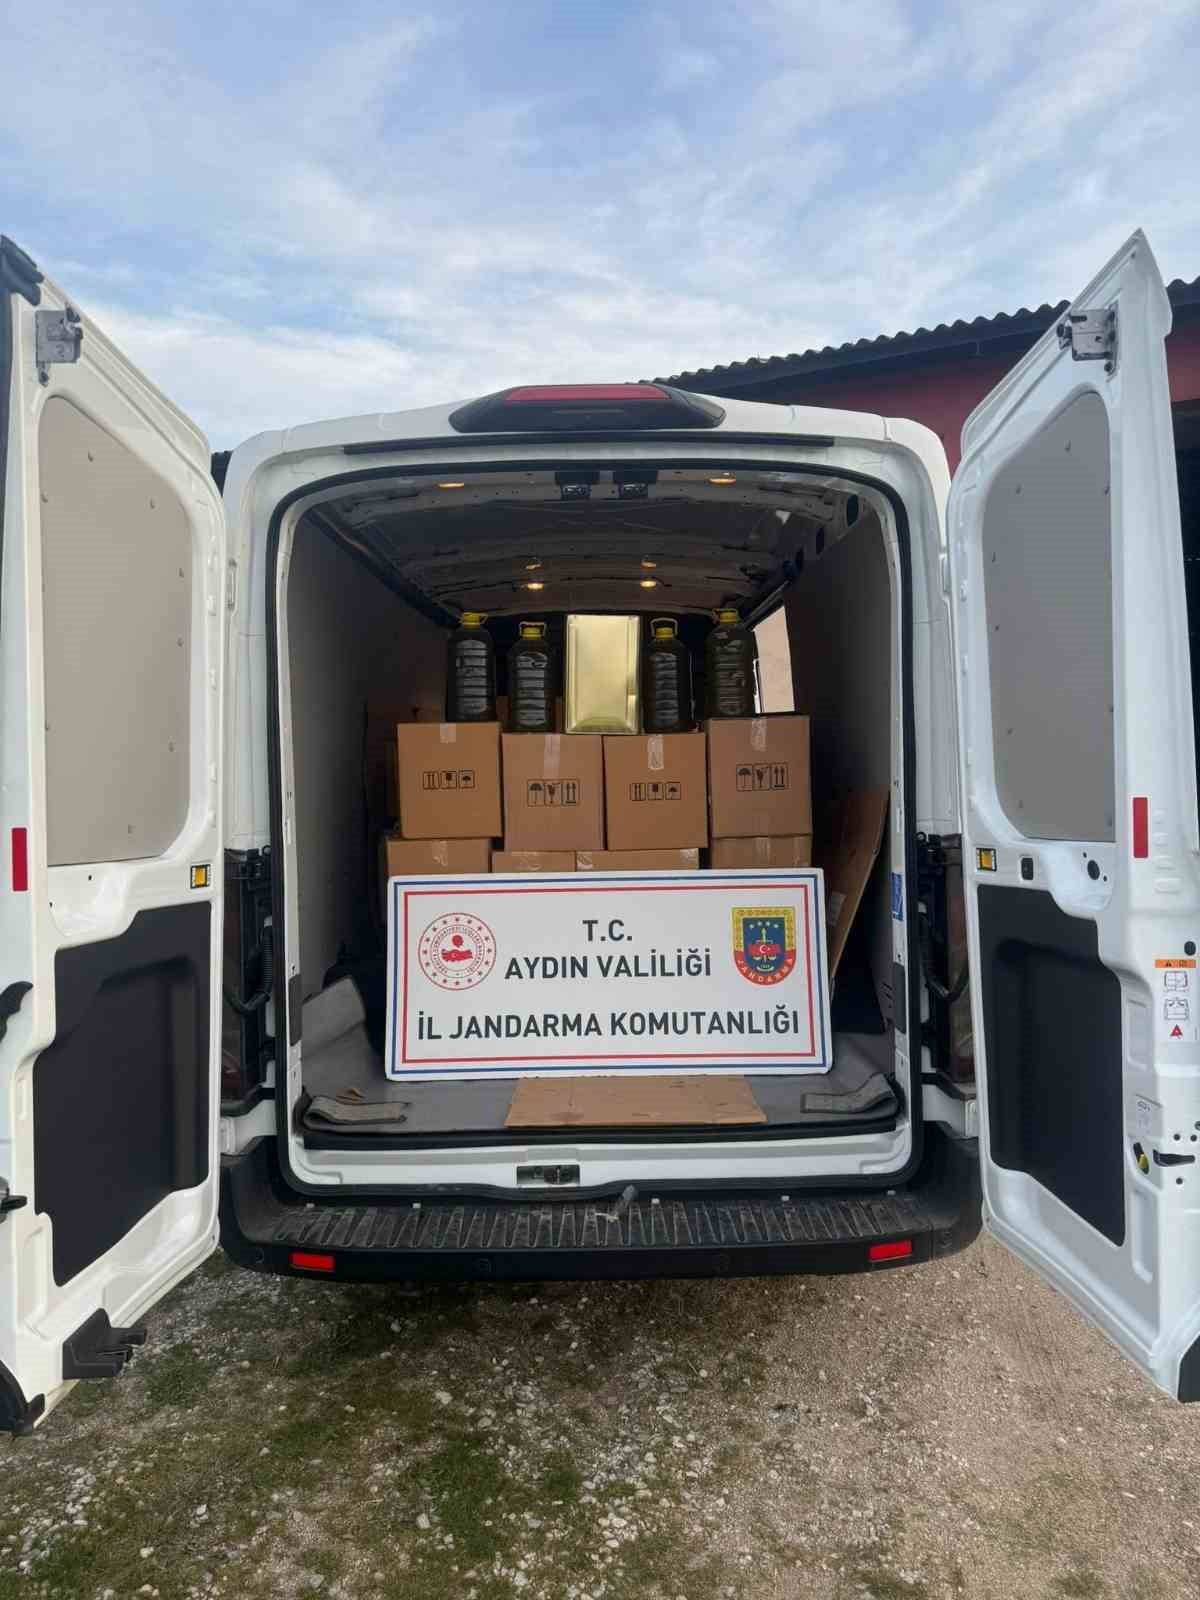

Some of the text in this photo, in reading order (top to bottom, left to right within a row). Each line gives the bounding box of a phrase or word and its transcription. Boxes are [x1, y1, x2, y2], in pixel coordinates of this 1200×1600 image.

[582, 919, 633, 942] T.C.
[504, 948, 711, 980] AYDIN VALİLİĞİ
[418, 1004, 799, 1040] İL JANDARMA KOMUTANLIĞI
